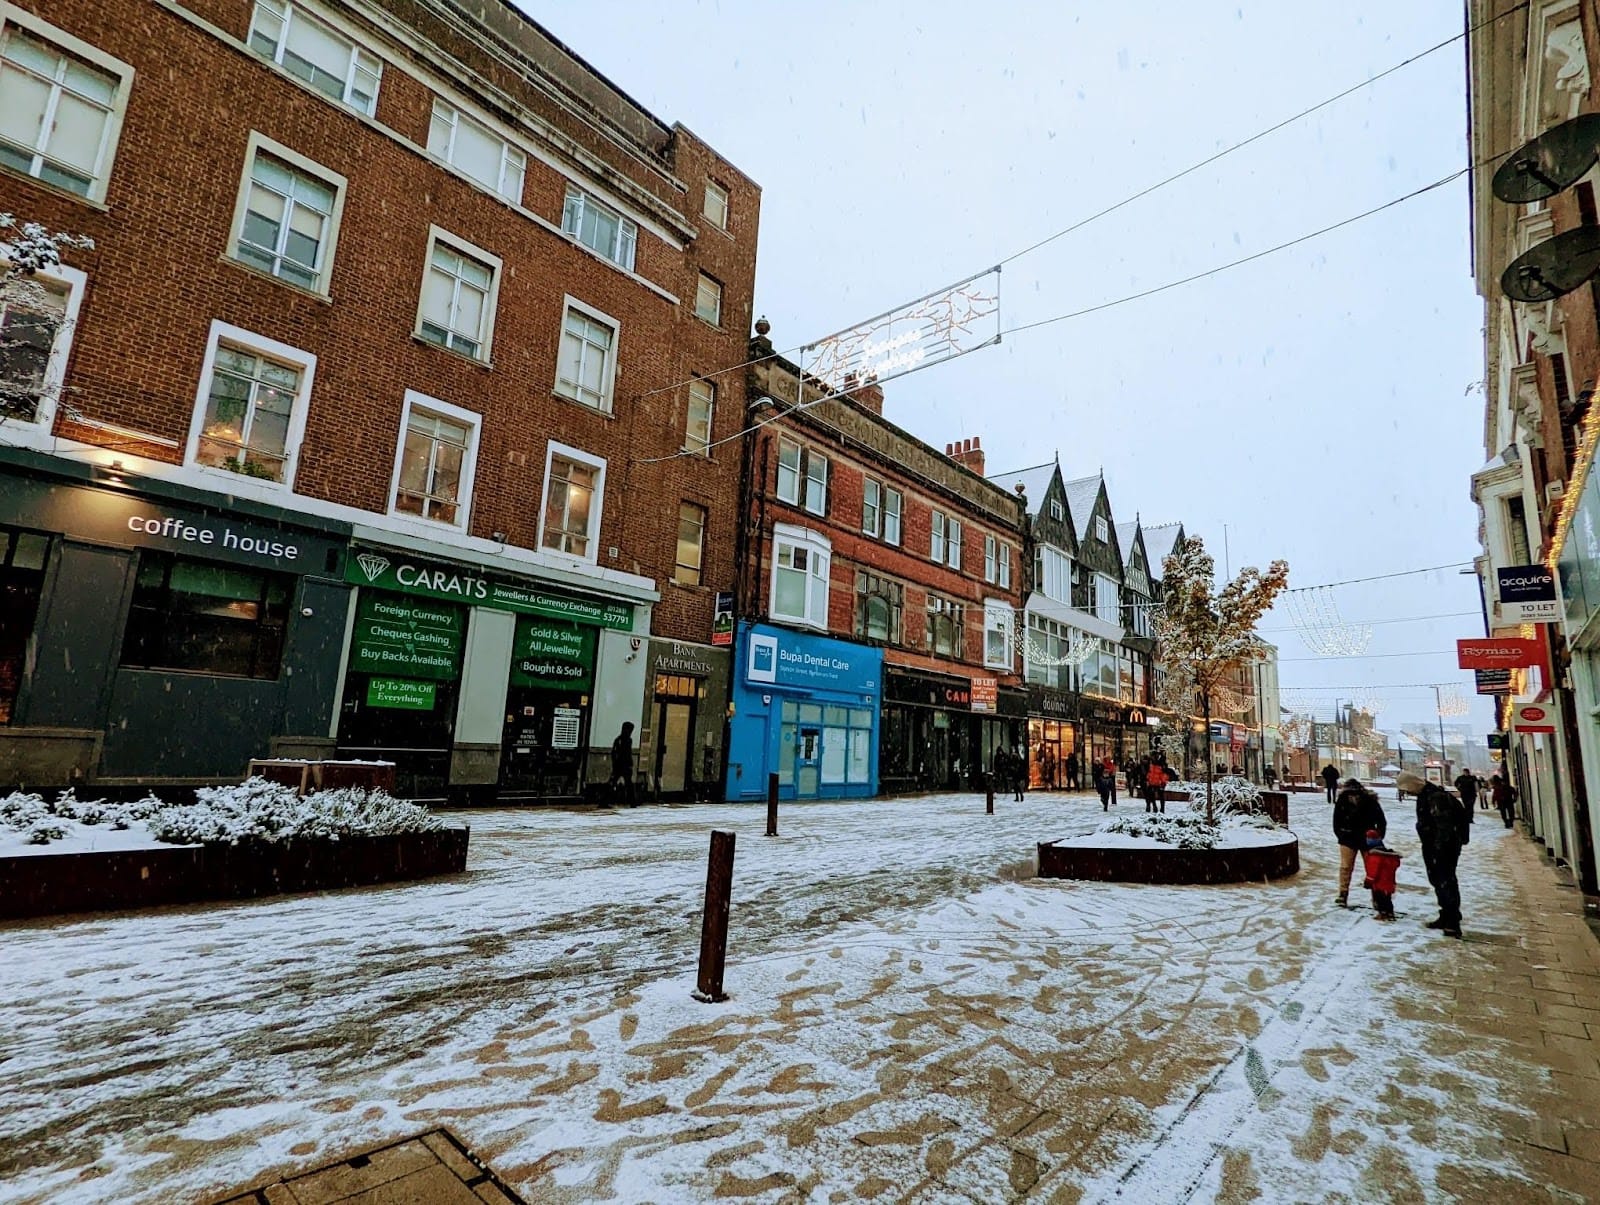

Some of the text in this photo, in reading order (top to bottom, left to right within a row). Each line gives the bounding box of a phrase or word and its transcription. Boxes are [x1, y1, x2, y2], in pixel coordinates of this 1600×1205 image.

[127, 516, 299, 559] coffee house
[396, 564, 488, 599] CARATS
[1499, 575, 1553, 586] acquire
[493, 588, 529, 602] Jewellers
[536, 596, 569, 610] Currency
[569, 602, 602, 616] Exchange
[1520, 603, 1556, 612] TO LET
[374, 602, 453, 625] Foreign Currency
[603, 612, 629, 625] 537791
[370, 625, 450, 647] Cheques Cashing
[530, 627, 583, 643] Gold & Silver
[529, 640, 581, 658] All Jewellery
[673, 643, 697, 658] BANK
[1461, 647, 1523, 656] Ryman
[361, 648, 453, 668] Buy Backs Available
[655, 655, 711, 673] APARTMENTS
[780, 649, 850, 671] Bupa Dental Care
[523, 661, 583, 677] Bought & Sold
[372, 680, 434, 694] Up To 20% Off
[377, 692, 424, 706] Everything
